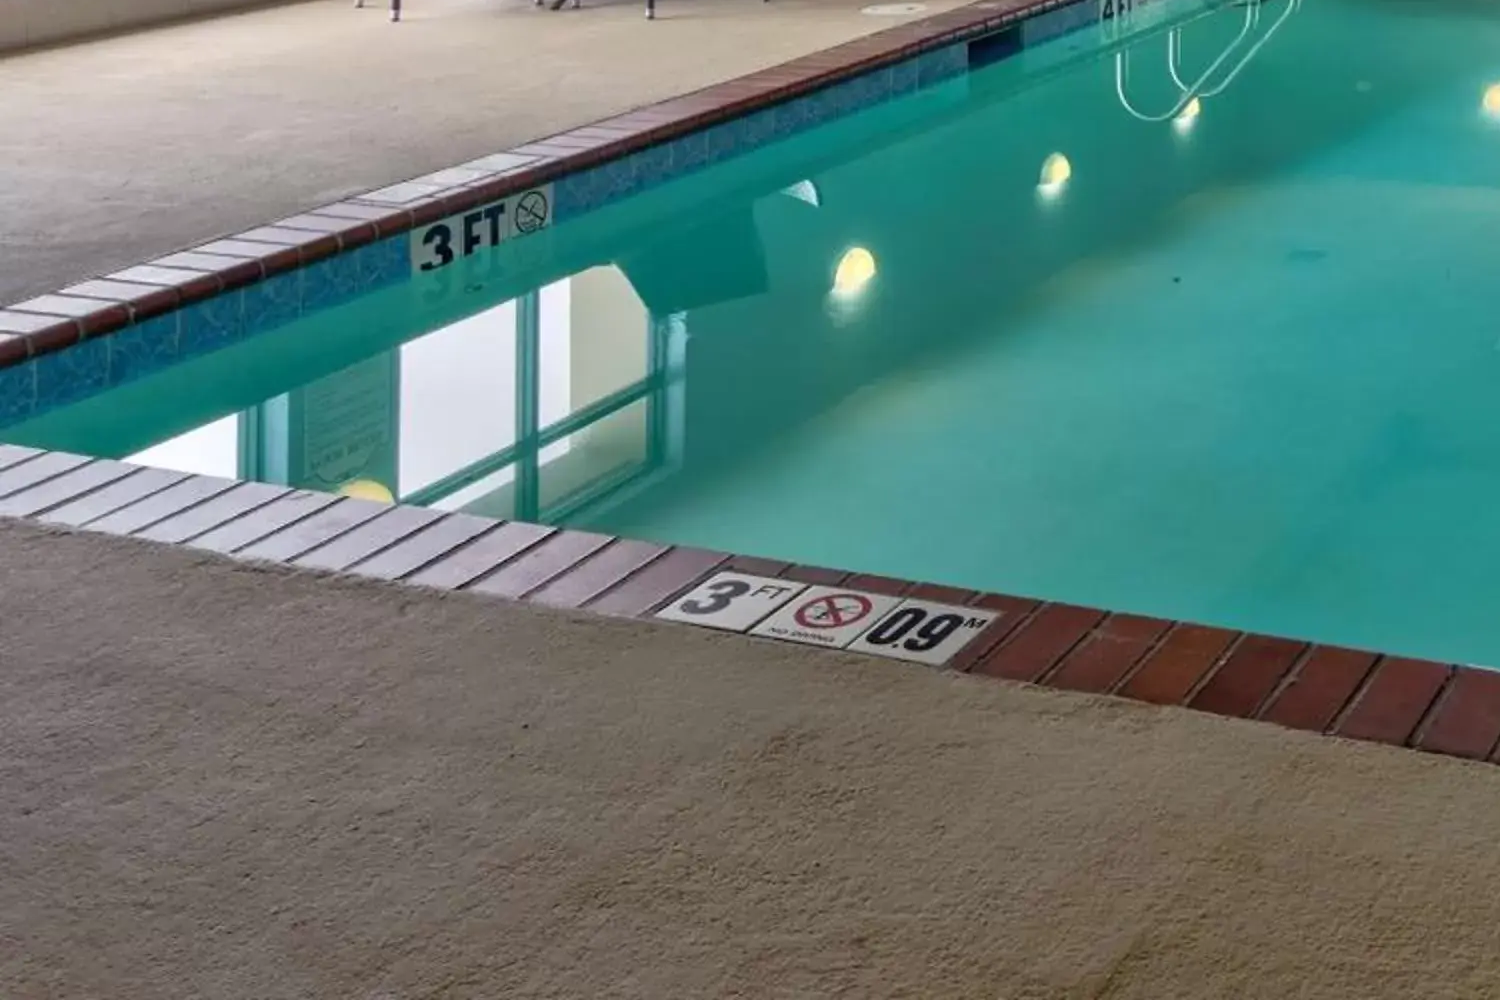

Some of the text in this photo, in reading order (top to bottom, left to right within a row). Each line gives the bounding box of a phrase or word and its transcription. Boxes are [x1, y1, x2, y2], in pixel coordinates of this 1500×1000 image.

[420, 203, 506, 272] 3 FT
[681, 580, 794, 615] 3 FT
[866, 607, 988, 652] 0.9 M
